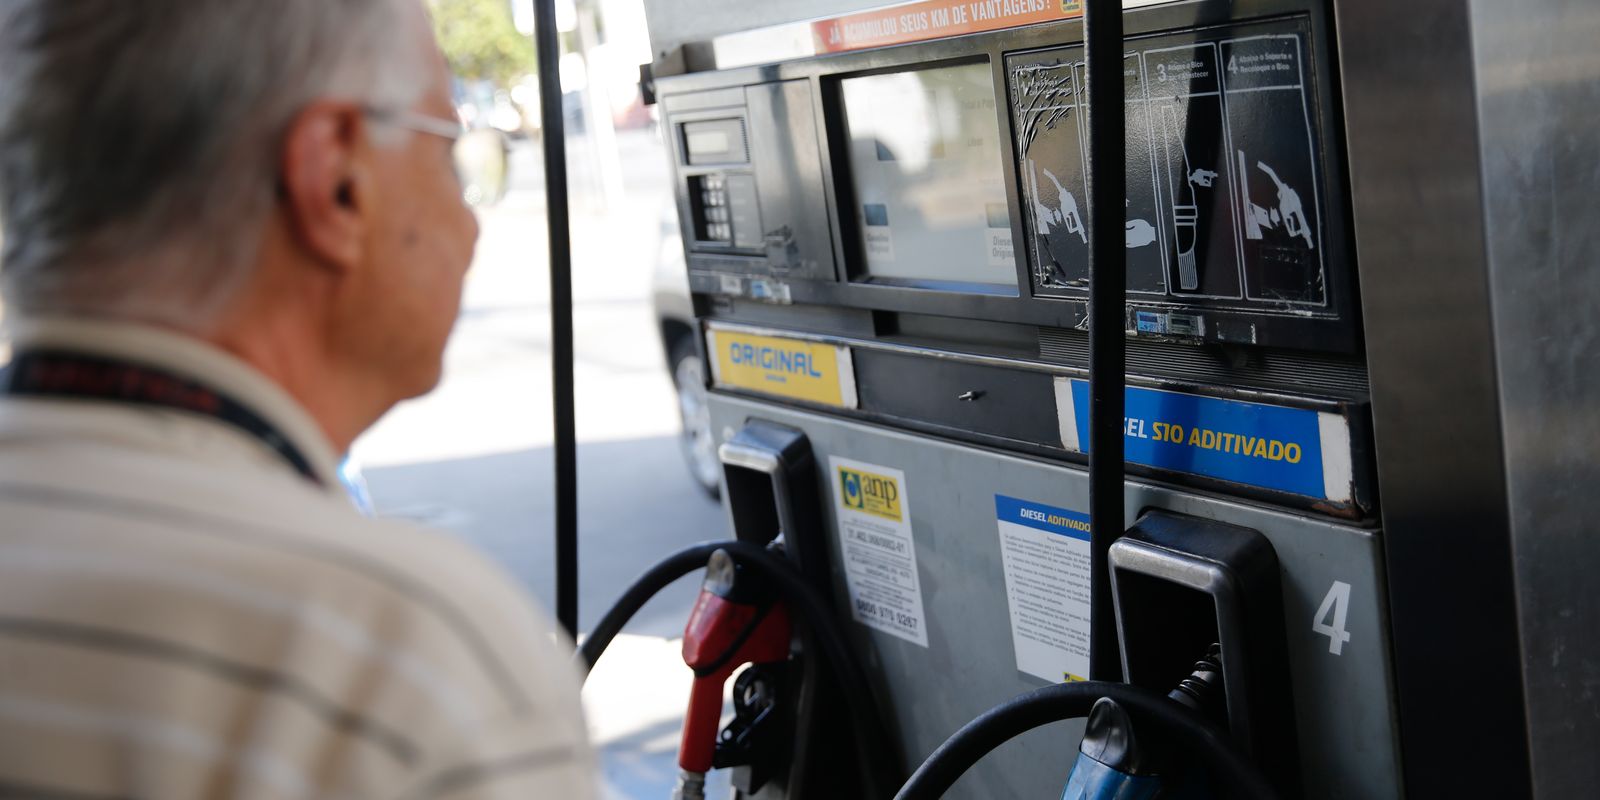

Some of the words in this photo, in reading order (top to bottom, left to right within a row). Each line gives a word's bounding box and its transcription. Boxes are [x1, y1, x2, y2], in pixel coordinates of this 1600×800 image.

[900, 11, 929, 33] SEUS
[930, 7, 950, 29] KM
[952, 5, 968, 25] DE
[1156, 63, 1167, 81] 3
[1227, 54, 1238, 75] 4
[730, 342, 822, 378] ORIGINAL
[1152, 421, 1184, 444] S10
[1188, 427, 1302, 464] ADITIVADO
[862, 475, 897, 509] anp
[1020, 507, 1047, 523] DIESEL
[1047, 514, 1091, 533] ADITIVADO
[1312, 580, 1351, 656] 4
